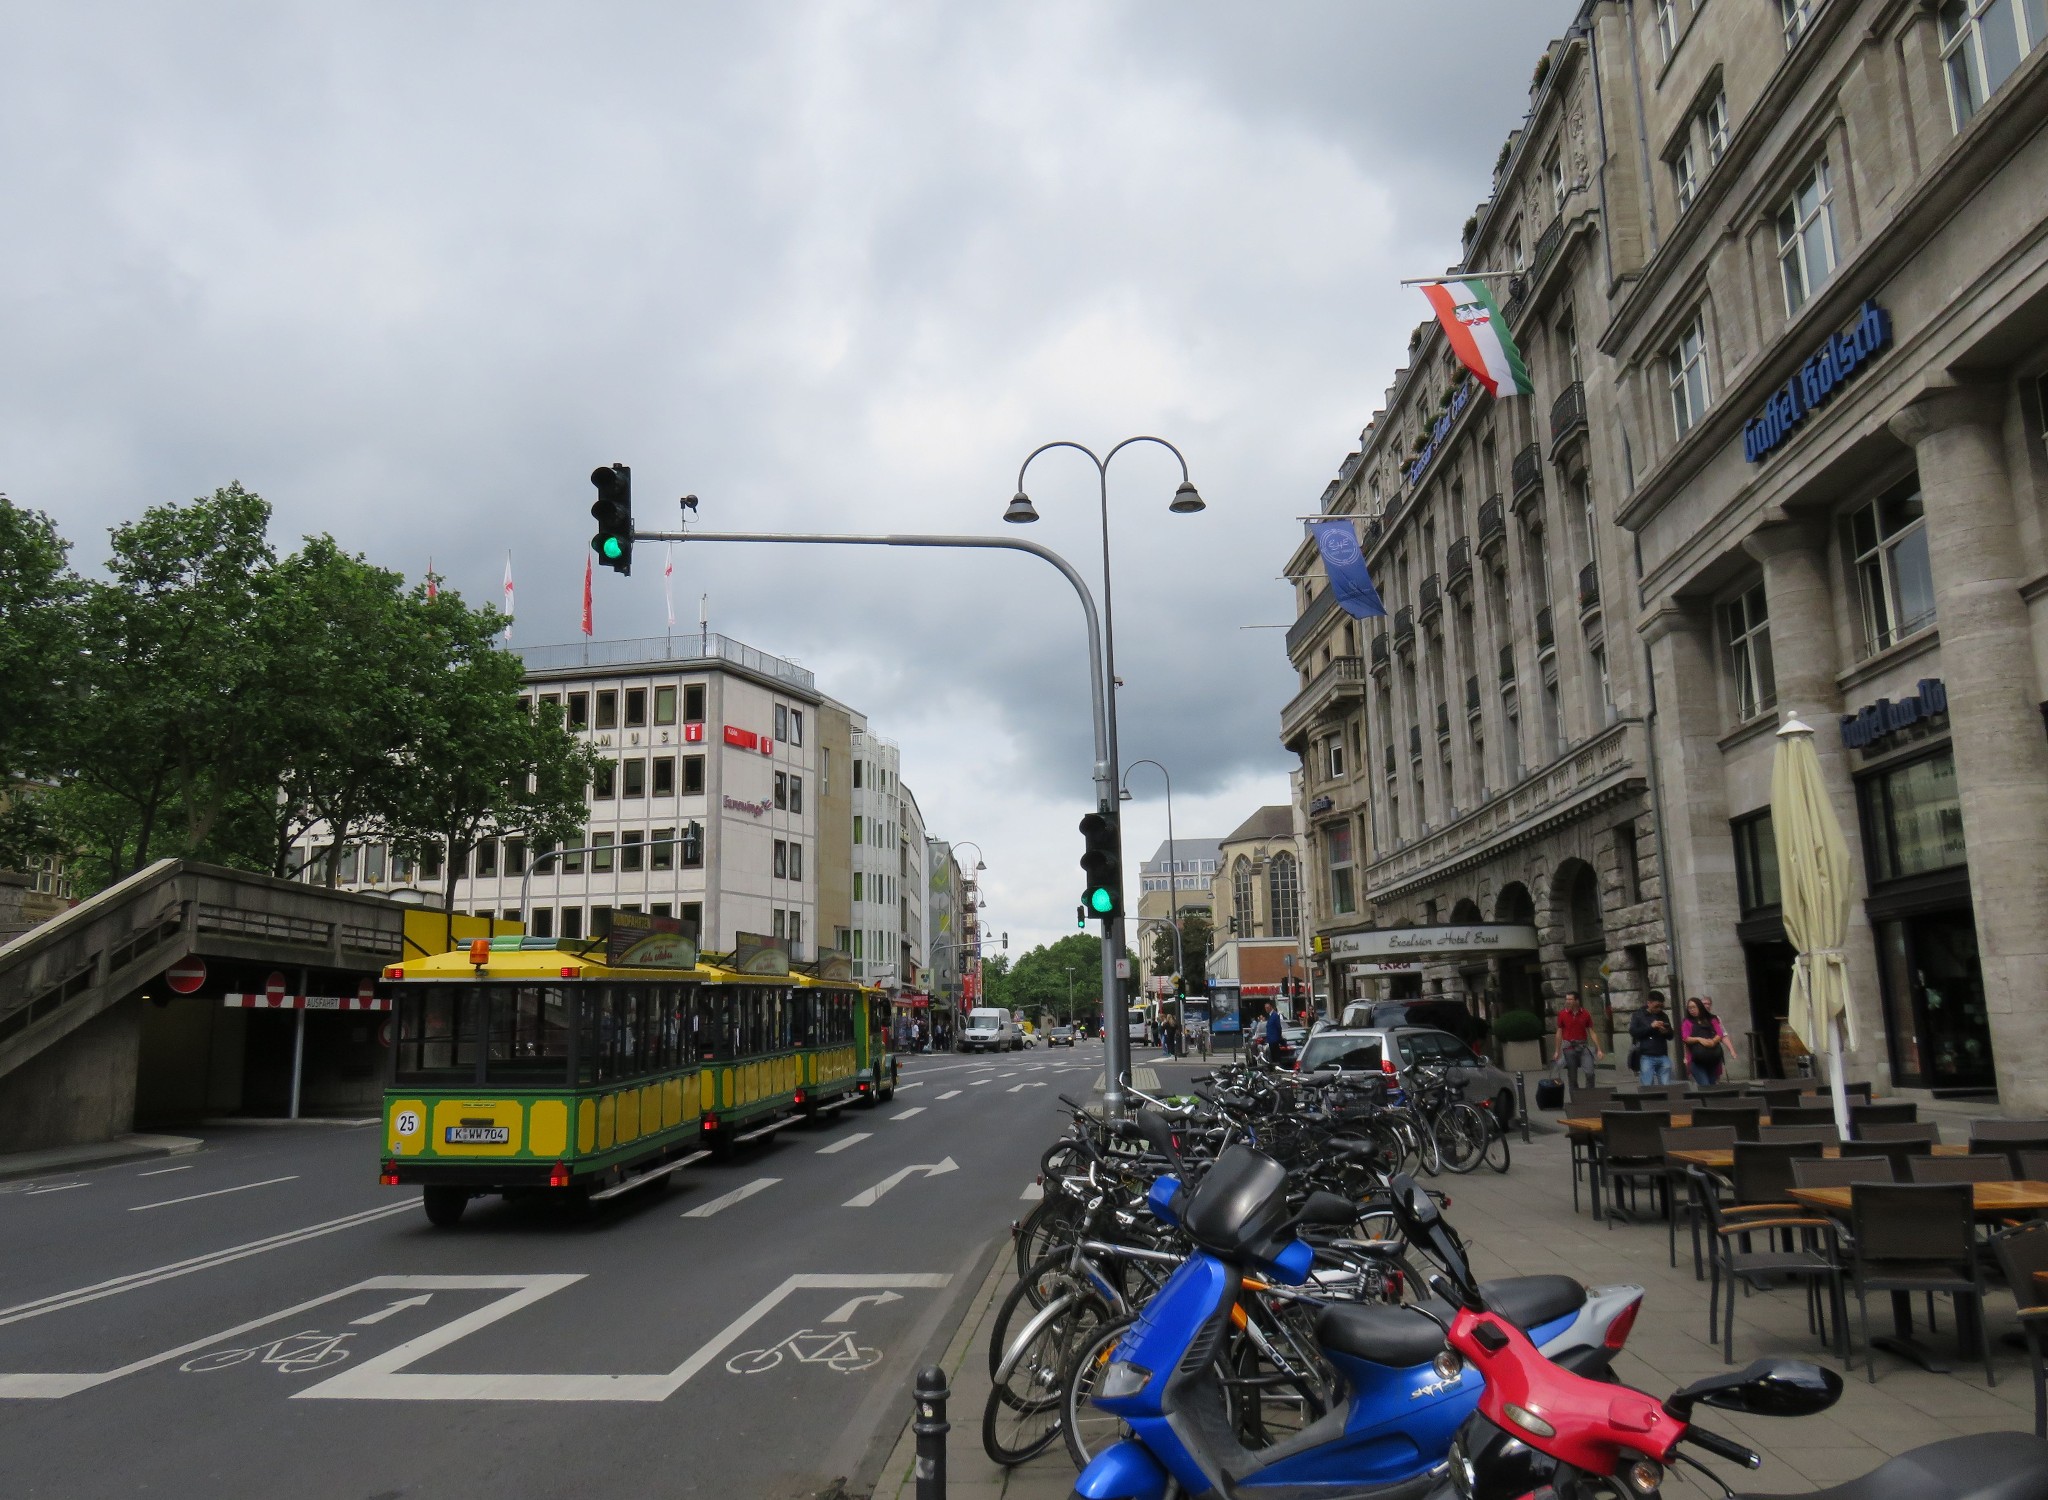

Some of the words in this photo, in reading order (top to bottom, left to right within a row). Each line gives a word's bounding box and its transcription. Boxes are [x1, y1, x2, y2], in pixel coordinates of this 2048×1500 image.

[1743, 376, 1804, 463] Gaffel
[1801, 299, 1886, 409] Kölsch
[1917, 678, 1947, 716] Do
[1388, 933, 1432, 948] Excelsior
[1437, 931, 1469, 946] Hotel
[1473, 932, 1499, 945] Ernst
[306, 997, 340, 1009] AUSFAHRT
[400, 1115, 415, 1133] 25
[455, 1129, 462, 1139] K
[484, 1128, 504, 1140] 704
[1256, 1333, 1298, 1377] SCOT
